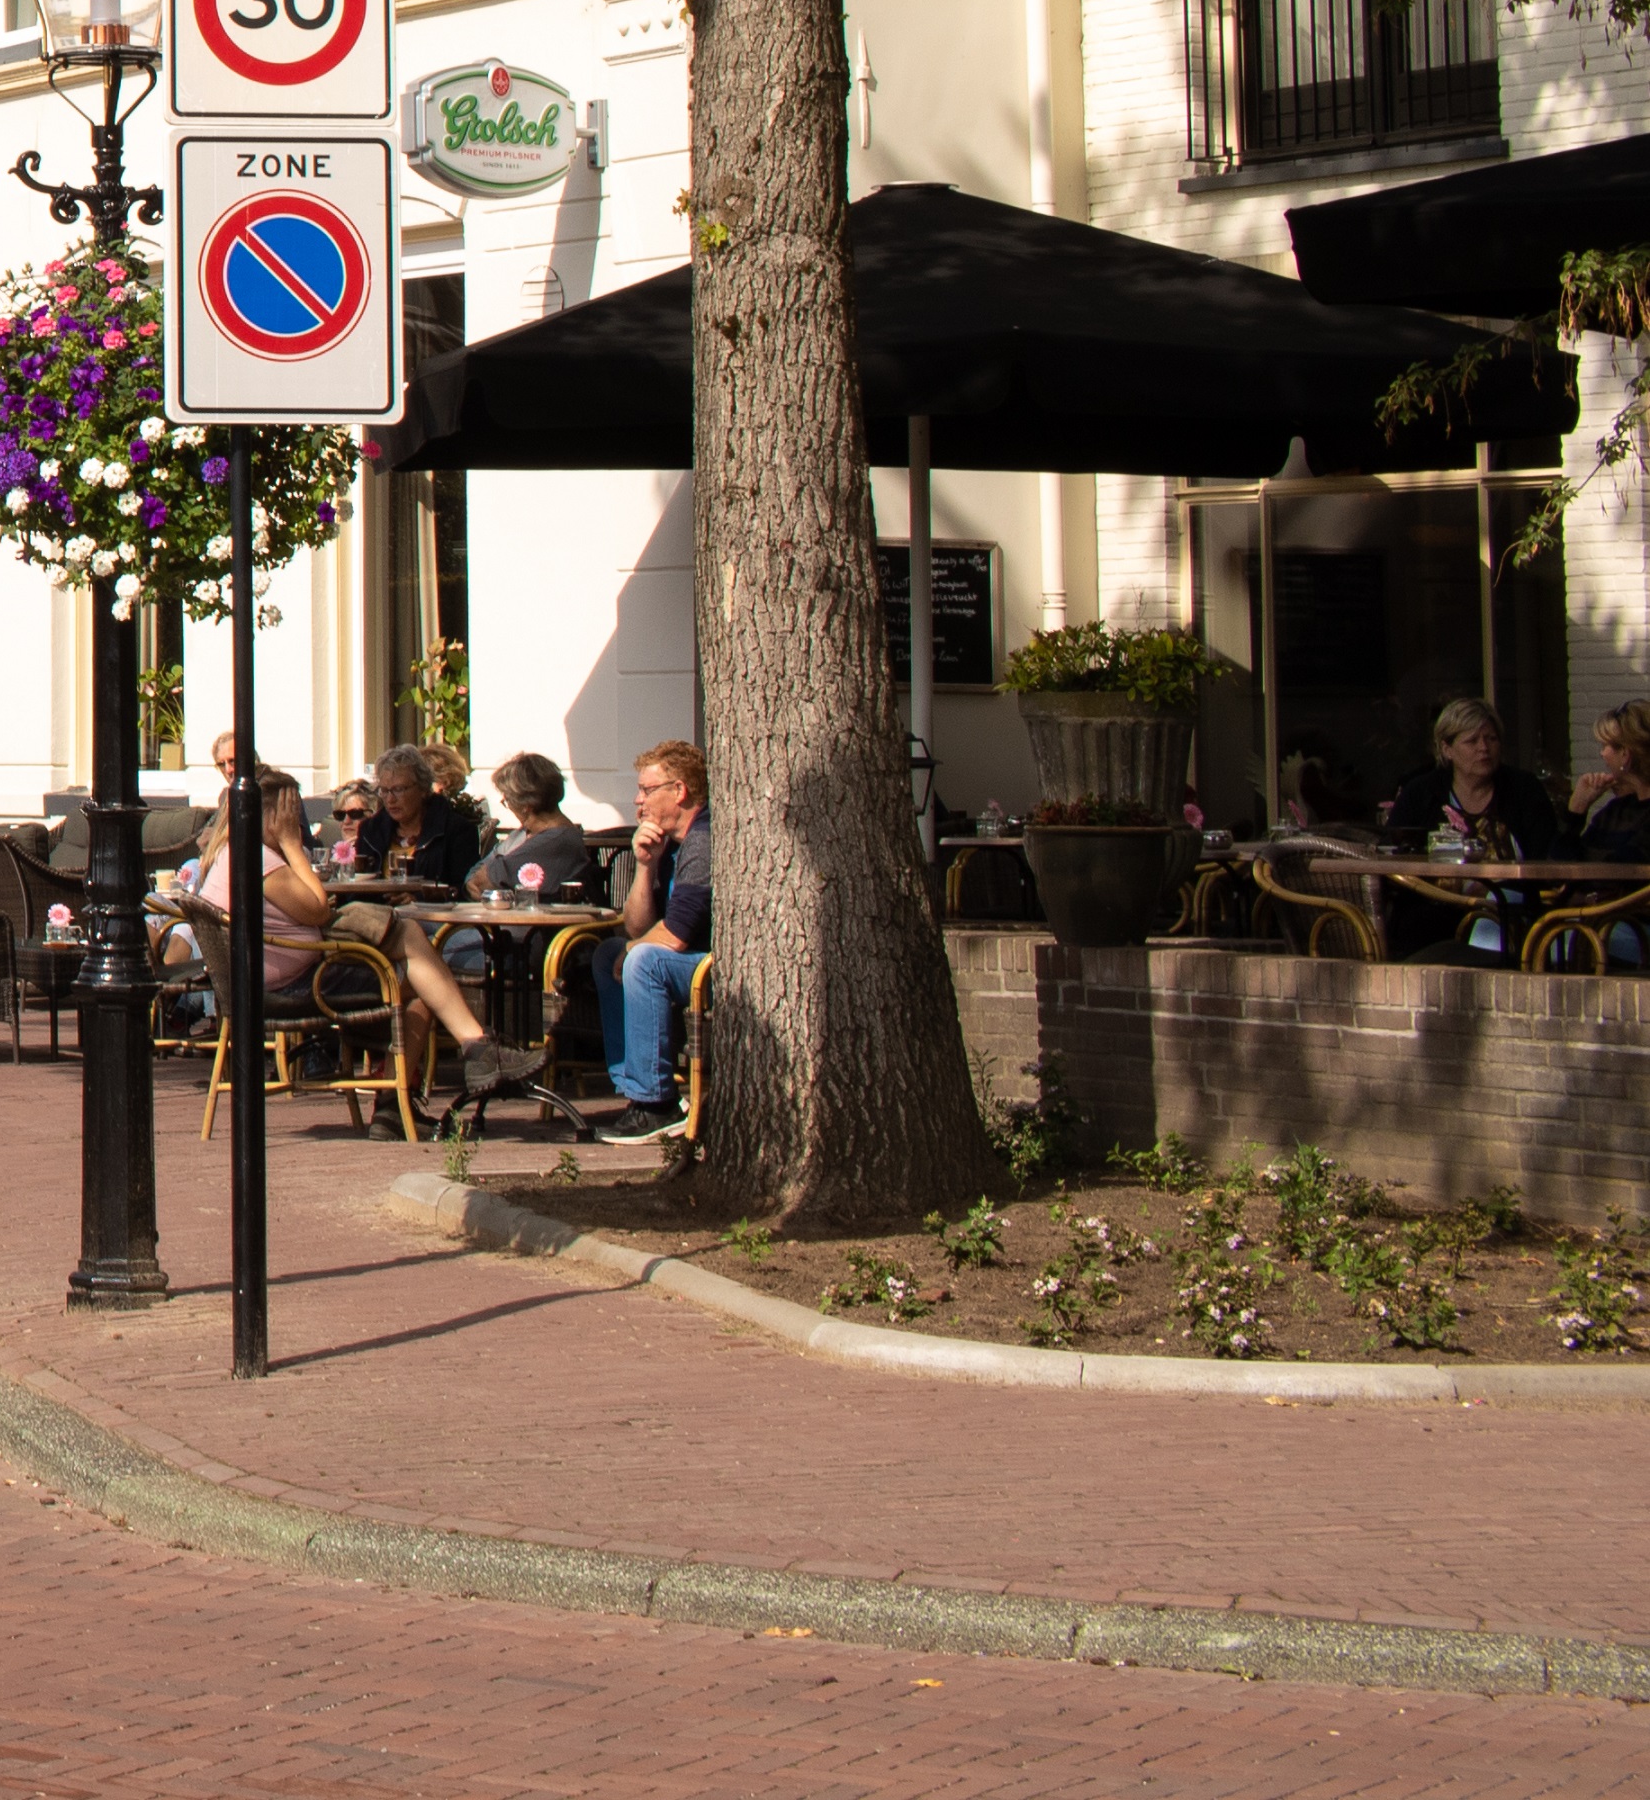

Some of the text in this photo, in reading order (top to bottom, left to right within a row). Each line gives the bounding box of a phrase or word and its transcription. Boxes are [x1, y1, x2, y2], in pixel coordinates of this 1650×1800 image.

[440, 94, 560, 151] Grolsch
[236, 153, 332, 178] ZONE
[460, 148, 541, 161] PREMIUM PILSNER
